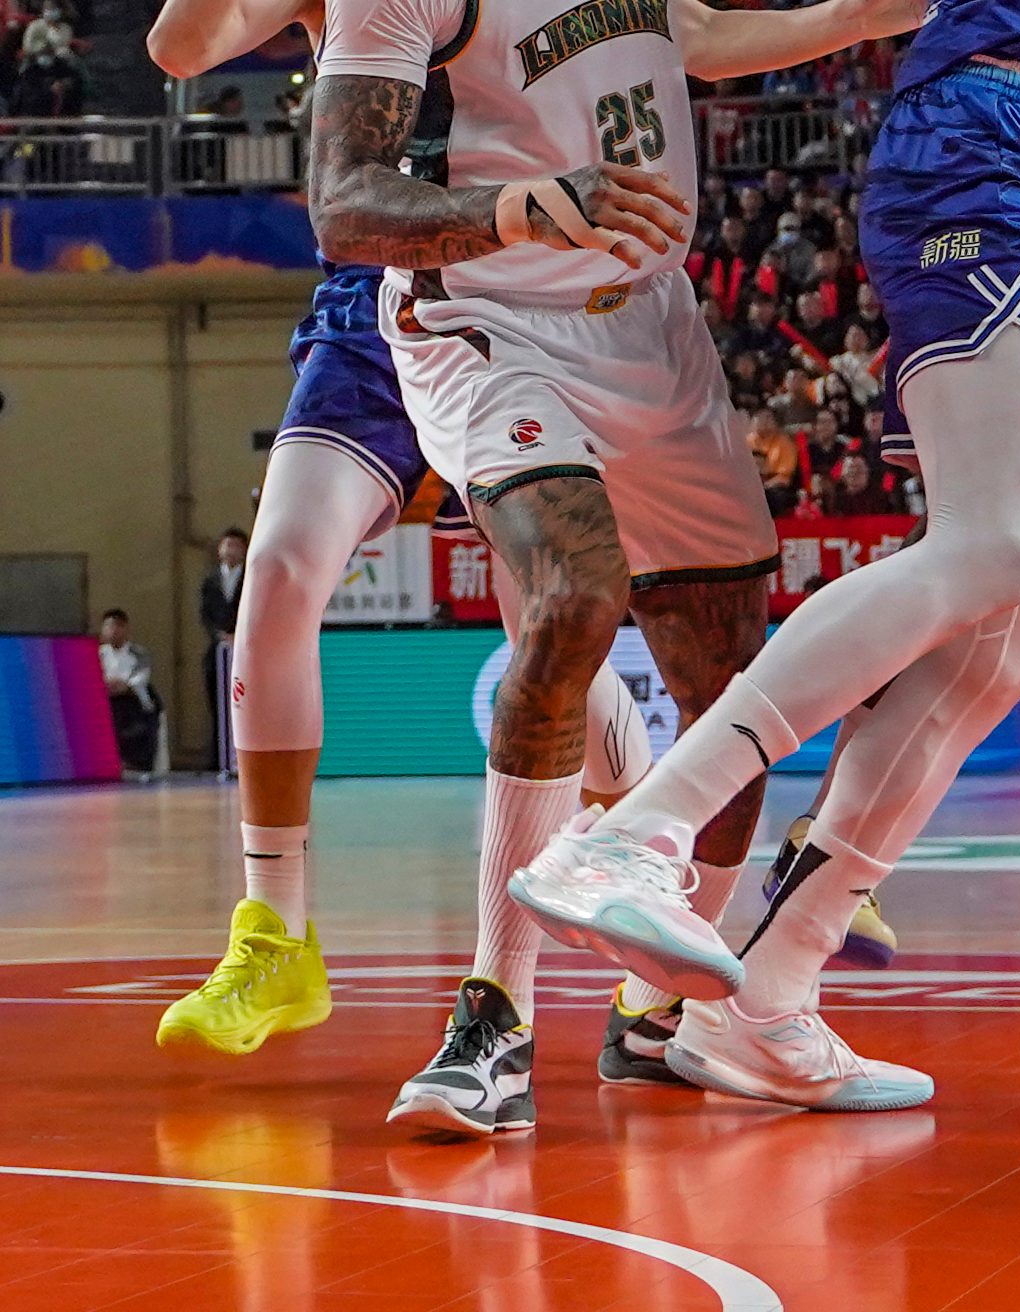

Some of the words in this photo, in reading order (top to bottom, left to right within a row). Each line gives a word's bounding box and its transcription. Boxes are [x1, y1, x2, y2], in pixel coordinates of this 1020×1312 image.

[595, 78, 667, 167] 25
[919, 228, 983, 270] 新疆
[449, 543, 490, 599] 新
